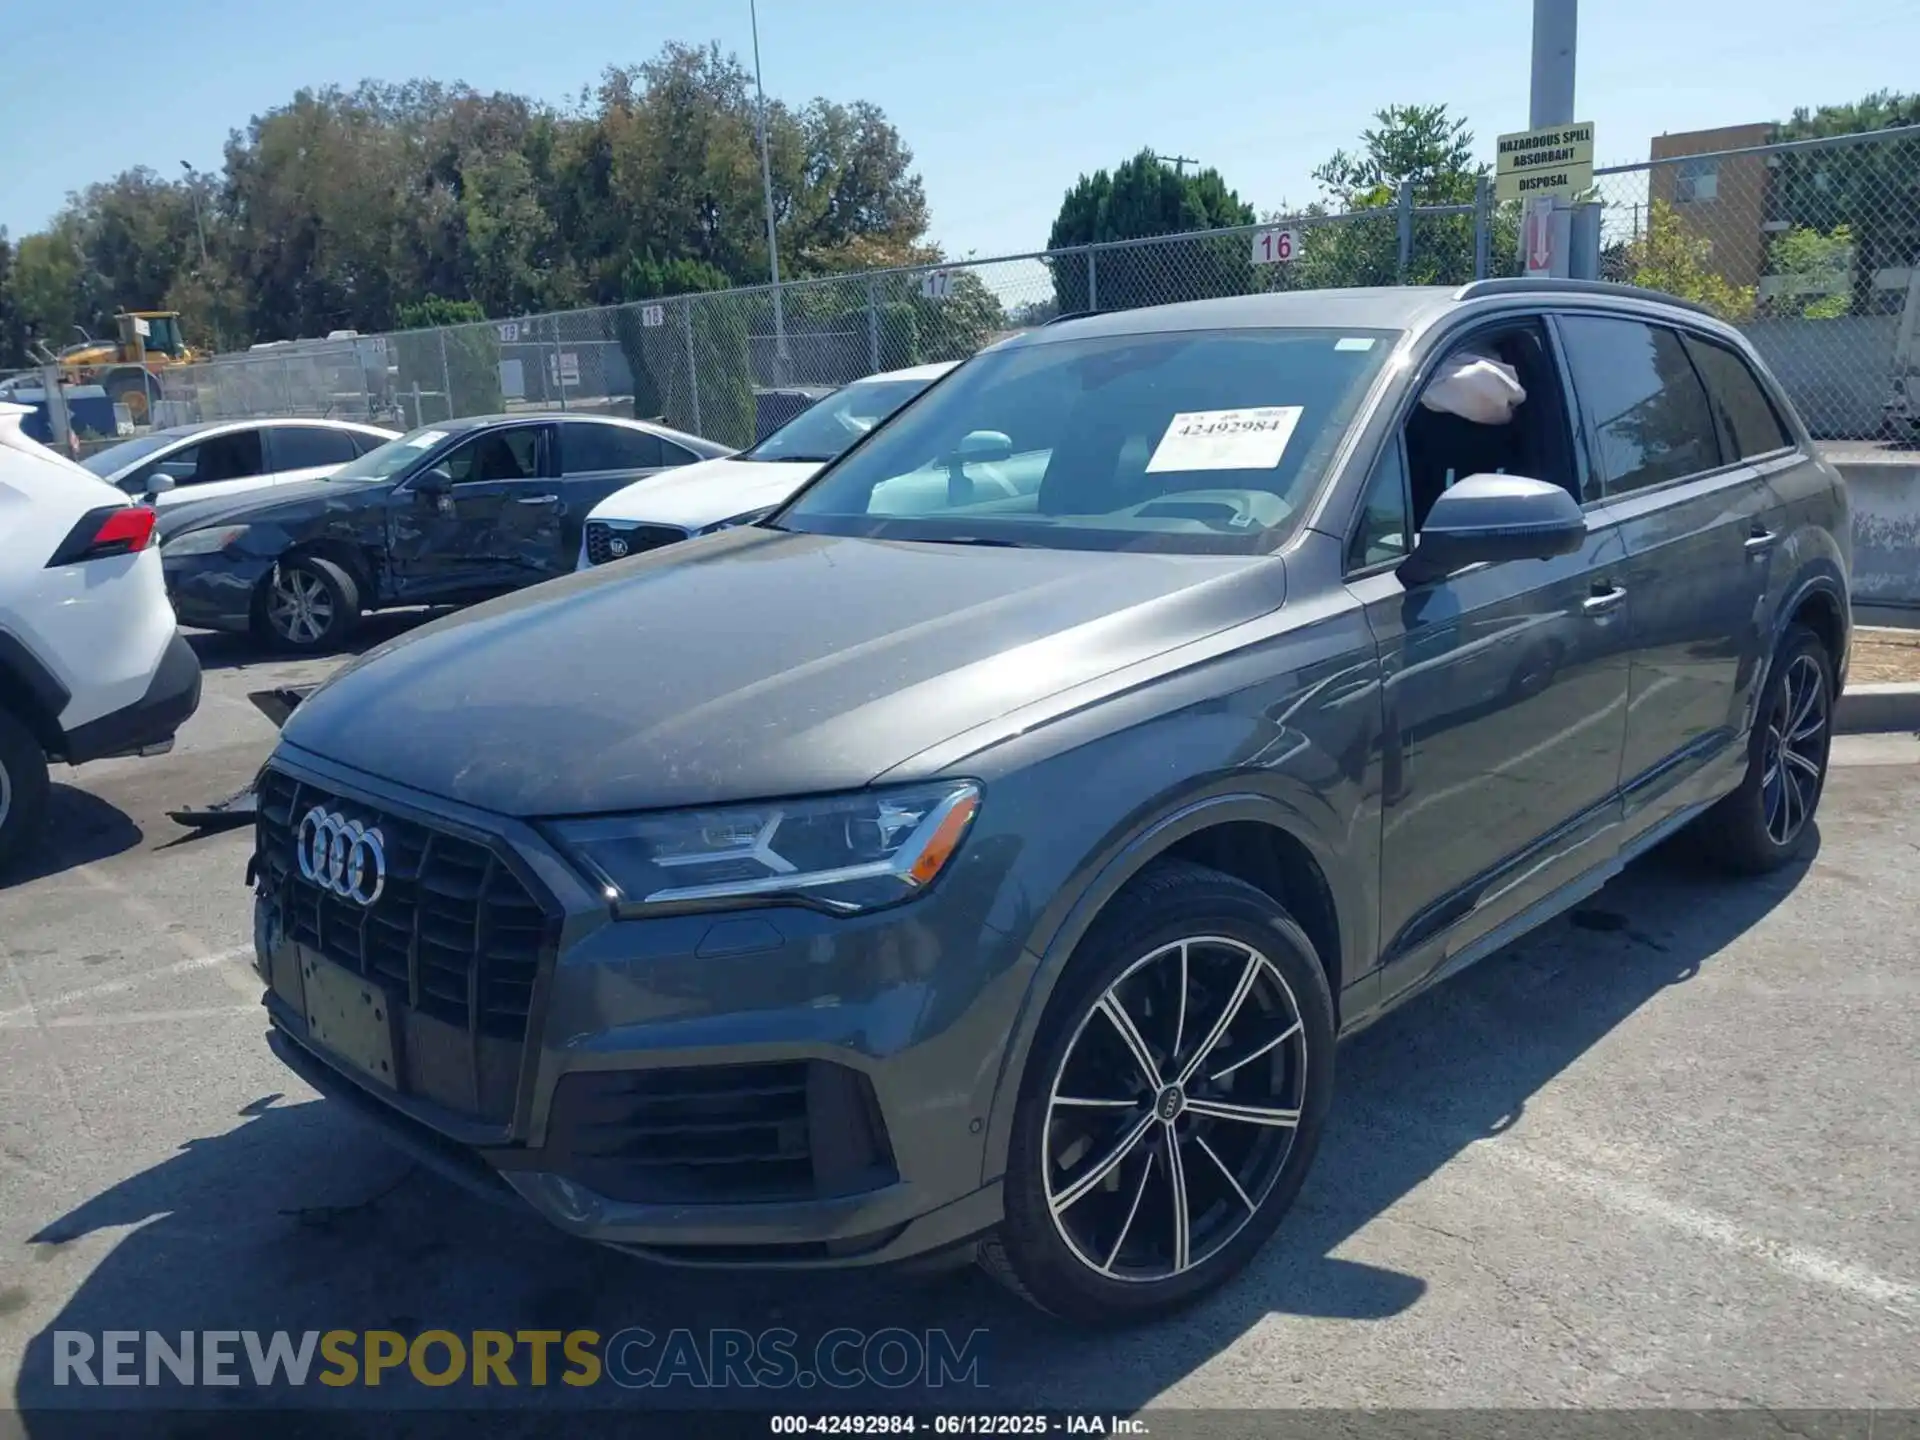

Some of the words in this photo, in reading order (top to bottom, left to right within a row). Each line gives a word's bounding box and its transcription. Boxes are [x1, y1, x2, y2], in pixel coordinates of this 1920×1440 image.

[1500, 133, 1560, 153] HAZARDOUS
[1563, 129, 1590, 144] SPILL
[1514, 148, 1575, 167] ABSORBANT
[1520, 174, 1568, 191] DISPOSAL
[1261, 233, 1291, 261] 16
[928, 272, 948, 295] 17
[503, 325, 516, 340] 19
[1178, 420, 1280, 436] 42492984
